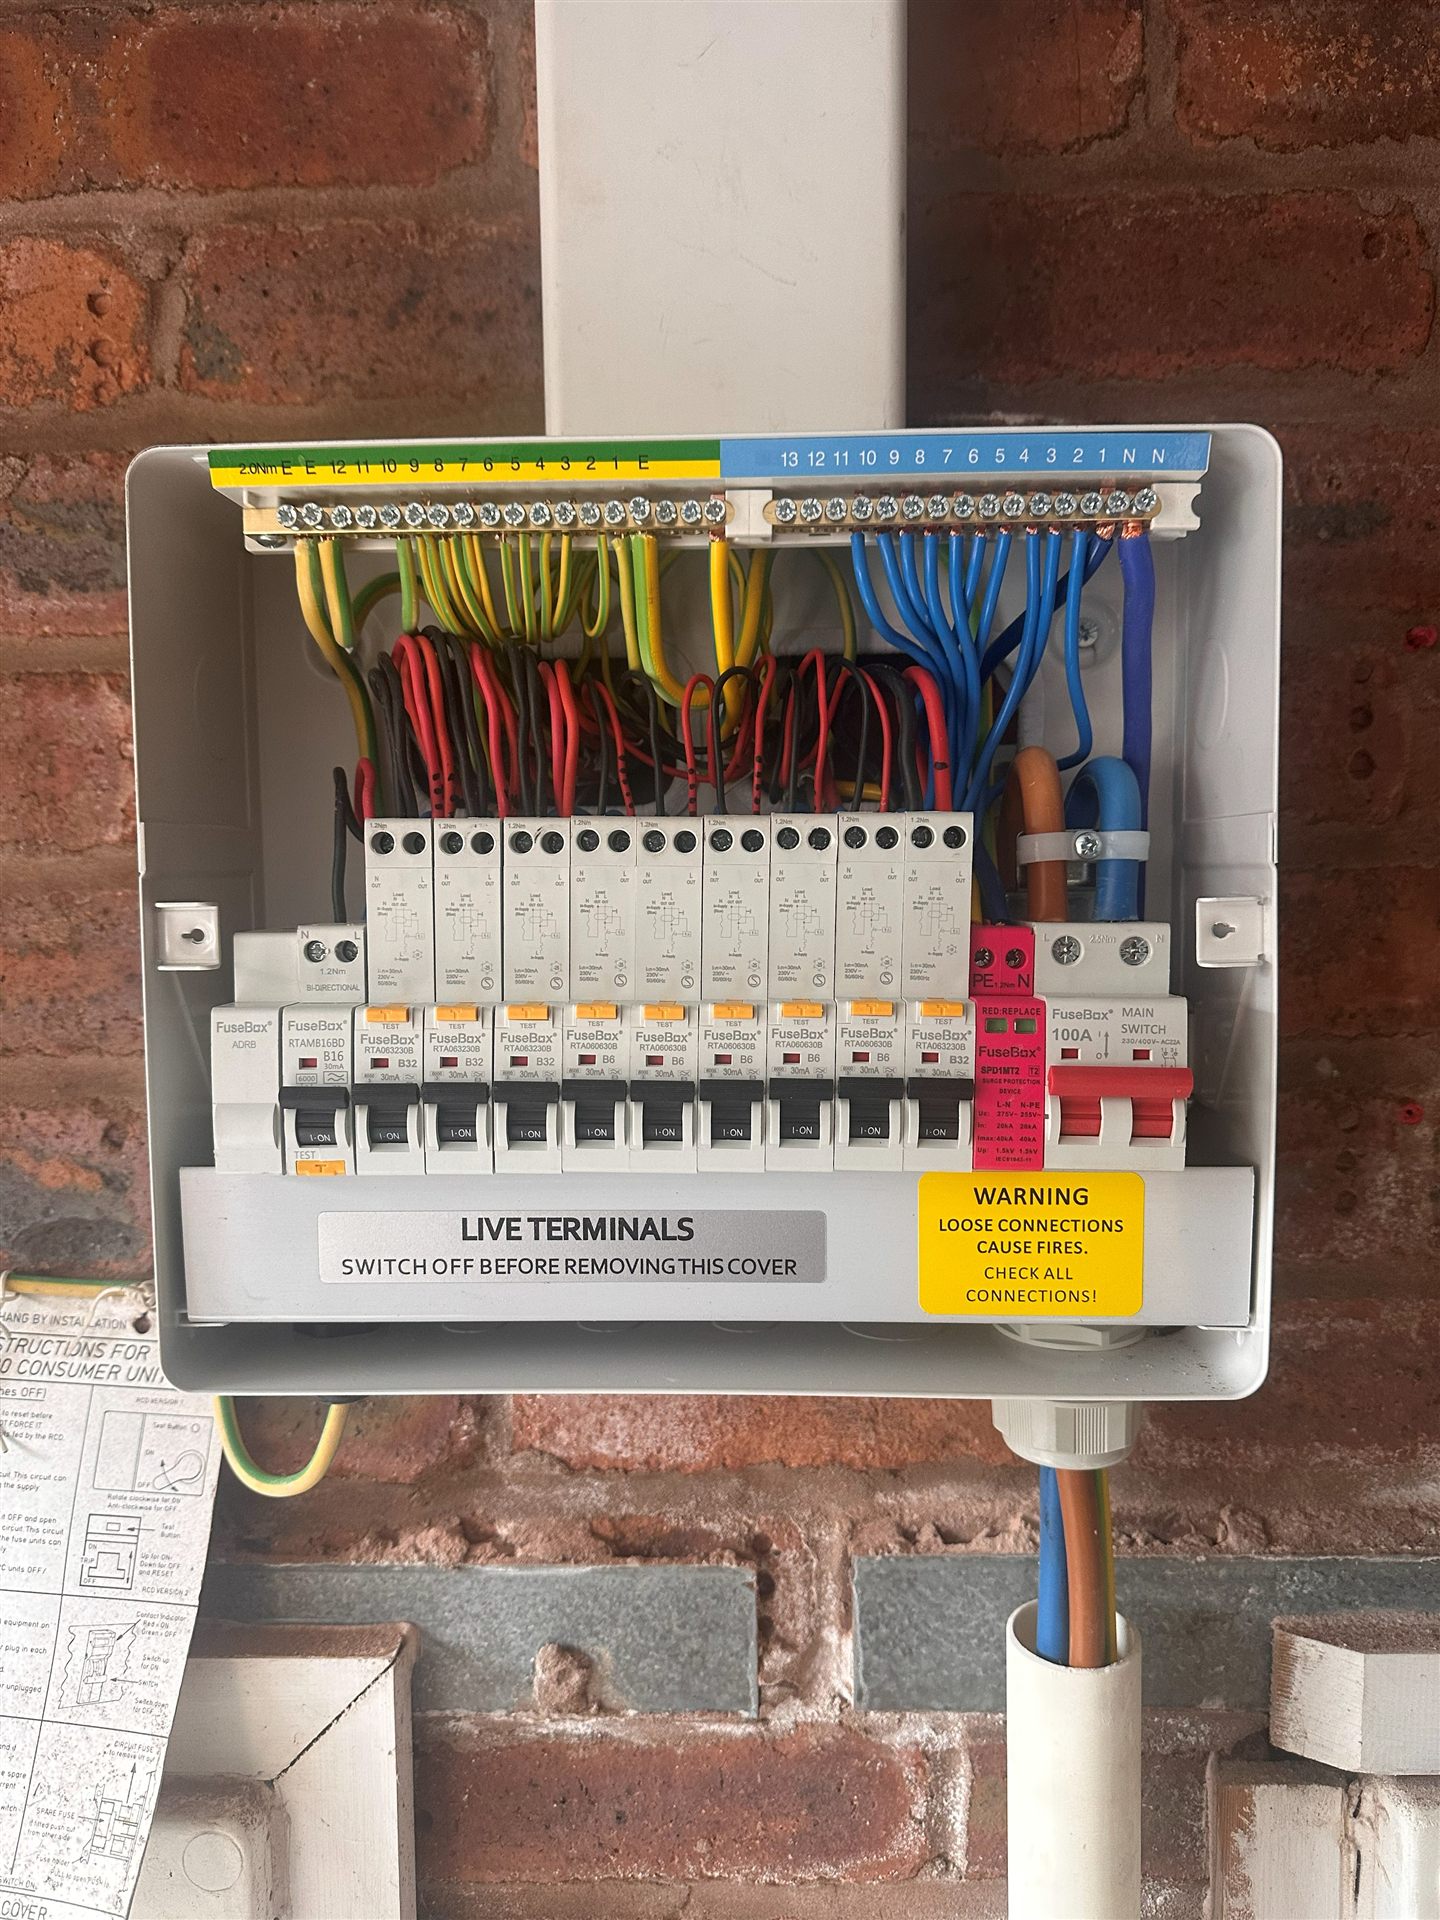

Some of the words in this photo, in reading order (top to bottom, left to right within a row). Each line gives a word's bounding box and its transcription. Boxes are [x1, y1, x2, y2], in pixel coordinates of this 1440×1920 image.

[782, 451, 798, 467] 13
[808, 451, 825, 467] 12
[834, 451, 848, 466] 11
[859, 451, 876, 466] 10
[889, 450, 899, 465] 9
[915, 450, 924, 465] 8
[943, 449, 952, 465] 7
[968, 449, 978, 464] 6
[995, 448, 1004, 464] 5
[1019, 448, 1029, 464] 4
[1046, 448, 1056, 463] 3
[1073, 448, 1082, 463] 2
[1099, 448, 1106, 463] 1
[1123, 448, 1135, 463] N
[1152, 448, 1165, 463] N
[239, 462, 277, 475] 2.0Nm
[282, 461, 292, 475] E
[306, 461, 316, 475] E
[330, 460, 346, 474] 12
[356, 460, 370, 474] 11
[380, 459, 397, 473] 10
[410, 459, 419, 473] 9
[434, 458, 444, 472] 8
[459, 458, 468, 472] 7
[484, 457, 493, 471] 6
[511, 457, 520, 471] 5
[536, 456, 545, 471] 4
[561, 456, 570, 471] 3
[586, 456, 596, 470] 2
[612, 456, 618, 470] 1
[639, 455, 648, 469] E
[301, 931, 309, 939] N
[973, 974, 993, 987] PE
[1018, 974, 1029, 987] N
[1122, 1008, 1153, 1017] MAIN
[1052, 1028, 1092, 1041] 100A
[1121, 1024, 1166, 1034] SWITCH
[232, 1041, 256, 1049] ADRB
[289, 1039, 345, 1047] RTAMB16BD
[570, 1042, 617, 1050] RTA060630B
[708, 1042, 755, 1050] RTA060630B
[845, 1040, 892, 1048] RTA060630B
[916, 1042, 966, 1050] RTA063230B
[364, 1045, 413, 1054] RTA063230B
[433, 1045, 480, 1053] RTA063230B
[324, 1051, 343, 1061] B16
[603, 1055, 615, 1064] B6
[741, 1055, 752, 1064] B6
[808, 1054, 820, 1062] B6
[877, 1053, 889, 1062] B6
[950, 1056, 969, 1065] B32
[398, 1059, 417, 1068] B32
[466, 1057, 483, 1066] B32
[536, 1057, 554, 1066] B32
[672, 1057, 684, 1065] B6
[586, 1068, 604, 1076] 30mA
[655, 1070, 674, 1078] 30mA
[723, 1068, 742, 1076] 30mA
[1030, 1067, 1038, 1075] T2
[294, 1151, 315, 1159] TEST
[974, 1187, 1089, 1205] WARNING
[462, 1217, 520, 1241] LIVE
[533, 1217, 695, 1241] TERMINALS
[939, 1219, 993, 1232] LOOSE
[998, 1219, 1123, 1232] CONNECTIONS
[977, 1241, 1031, 1254] CAUSE
[1038, 1241, 1088, 1254] FIRES.
[342, 1258, 427, 1275] SWITCH
[433, 1258, 475, 1275] OFF
[480, 1258, 559, 1275] BEFORE
[565, 1258, 675, 1275] REMOVING
[678, 1258, 724, 1275] THIS
[727, 1258, 797, 1275] COVER
[984, 1267, 1039, 1279] CHECK
[1044, 1267, 1072, 1279] ALL
[966, 1289, 1096, 1302] CONNECTIONS!
[32, 1314, 47, 1324] BY
[110, 1344, 150, 1360] FOR
[18, 1359, 121, 1380] CONSUMER
[1, 1900, 47, 1920] COVER
